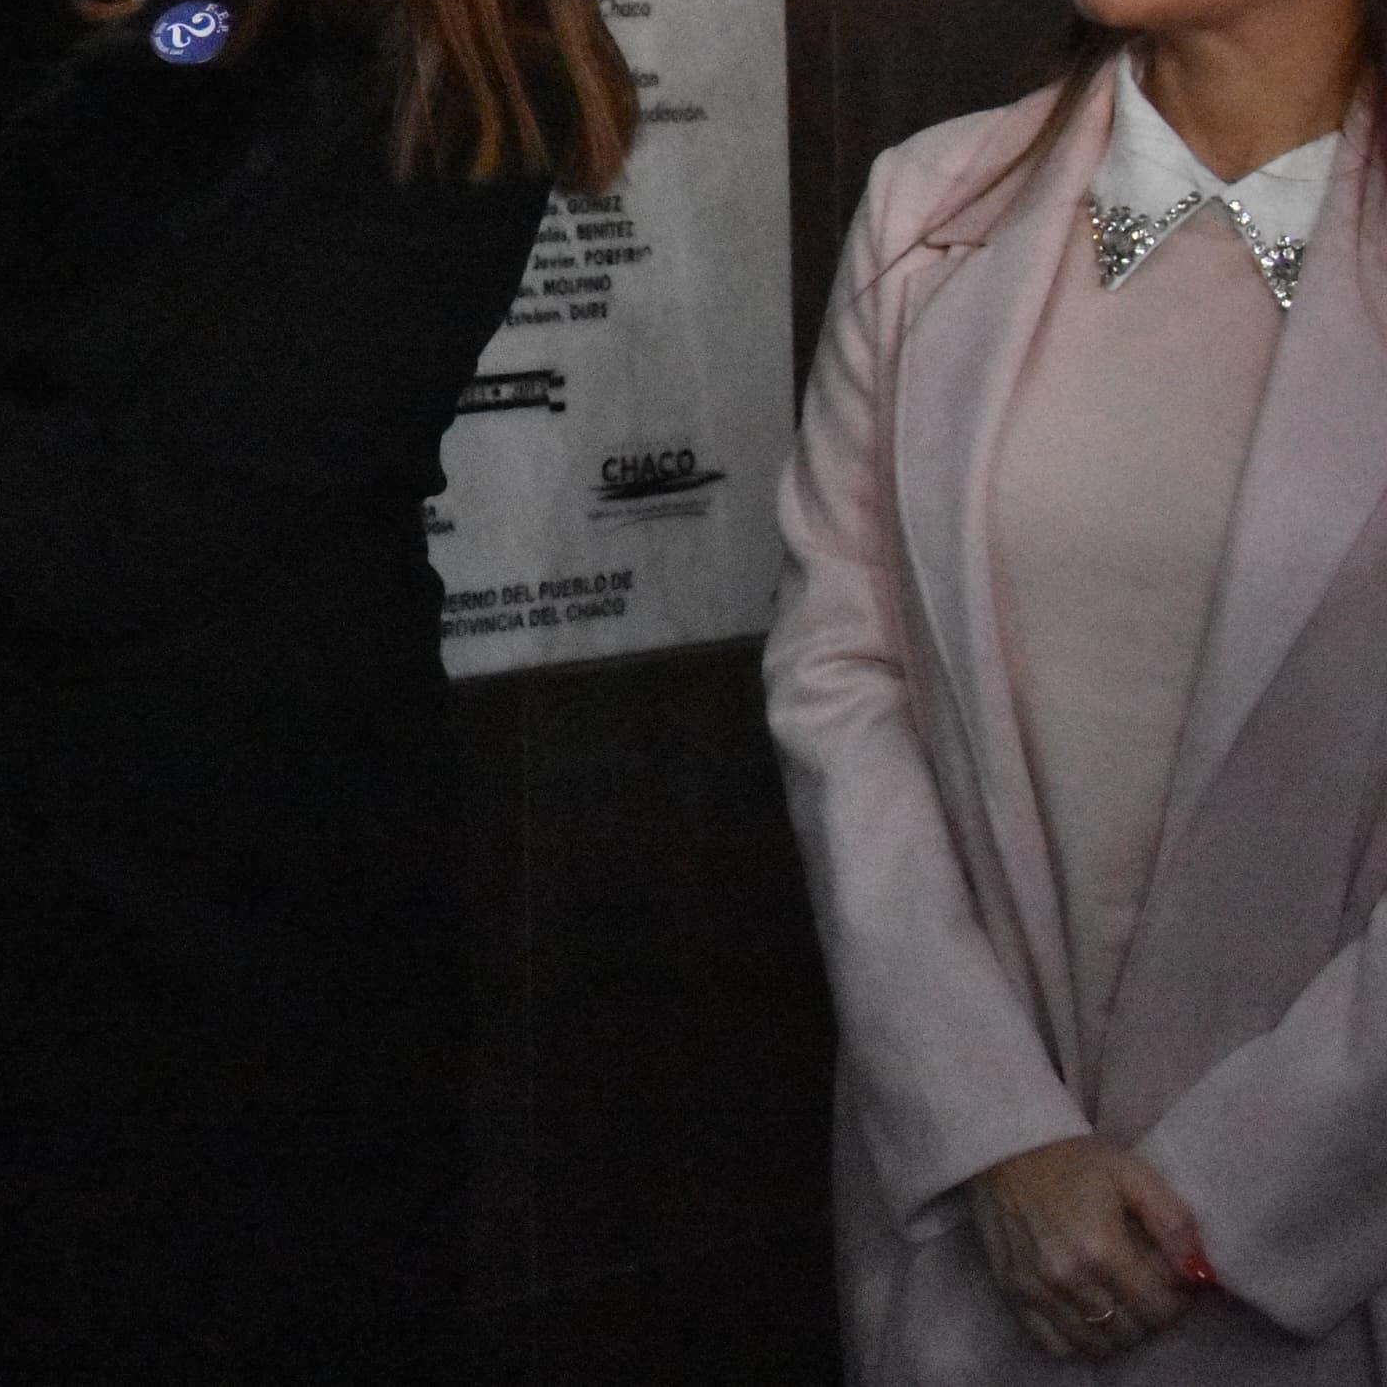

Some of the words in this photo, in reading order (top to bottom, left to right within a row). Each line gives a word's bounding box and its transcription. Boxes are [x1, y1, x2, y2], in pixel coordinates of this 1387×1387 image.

[601, 448, 696, 483] CHACO
[501, 584, 535, 606] DEL
[539, 573, 607, 600] PUEBLO
[611, 570, 633, 591] DE
[441, 613, 525, 639] ROVINCIA
[528, 607, 560, 628] DEL
[566, 597, 626, 622] CHACO
